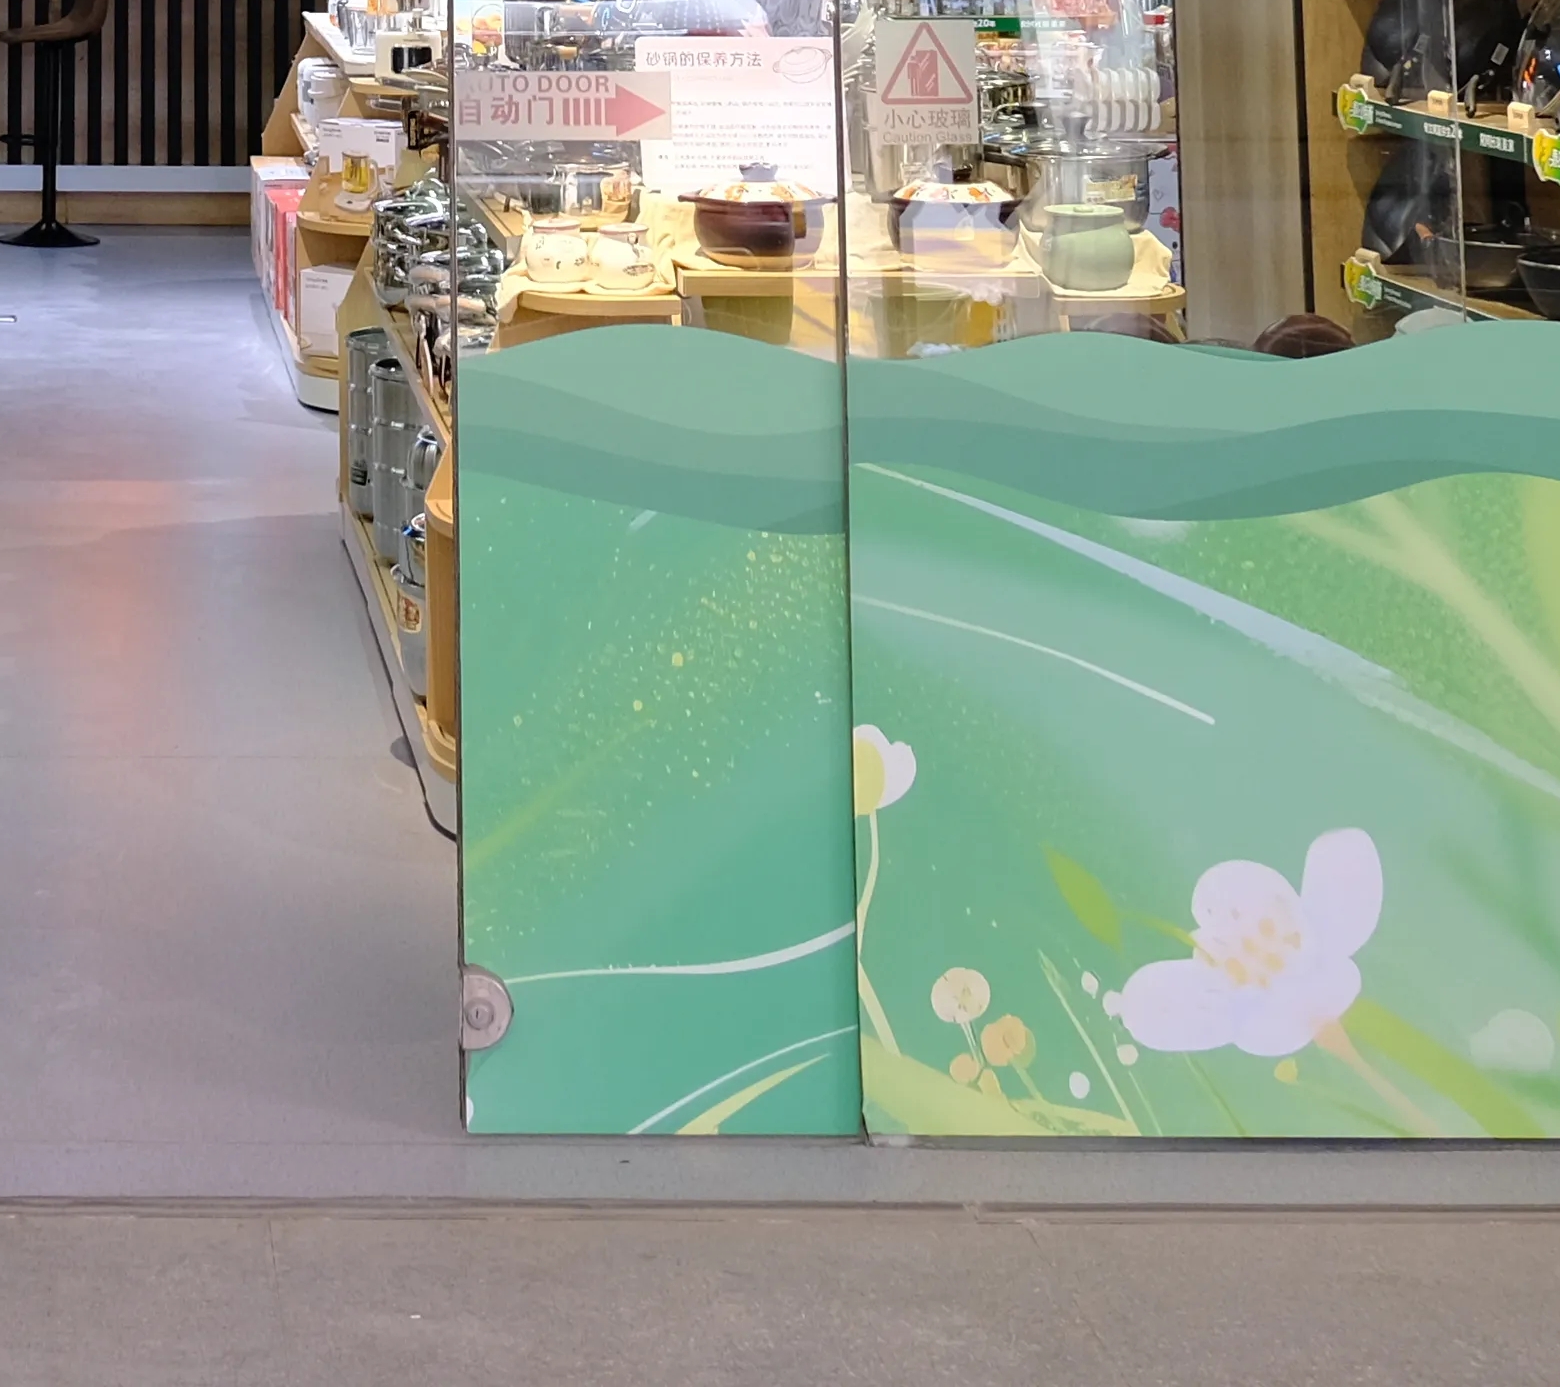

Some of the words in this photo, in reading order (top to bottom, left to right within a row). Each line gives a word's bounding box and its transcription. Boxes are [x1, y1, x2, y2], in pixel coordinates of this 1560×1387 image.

[645, 51, 763, 68] 砂锅的保养方法
[536, 74, 611, 95] DOOR
[458, 96, 555, 127] 自动门
[882, 107, 972, 129] 小心玻璃
[882, 131, 932, 144] Caution
[936, 131, 973, 144] Glass
